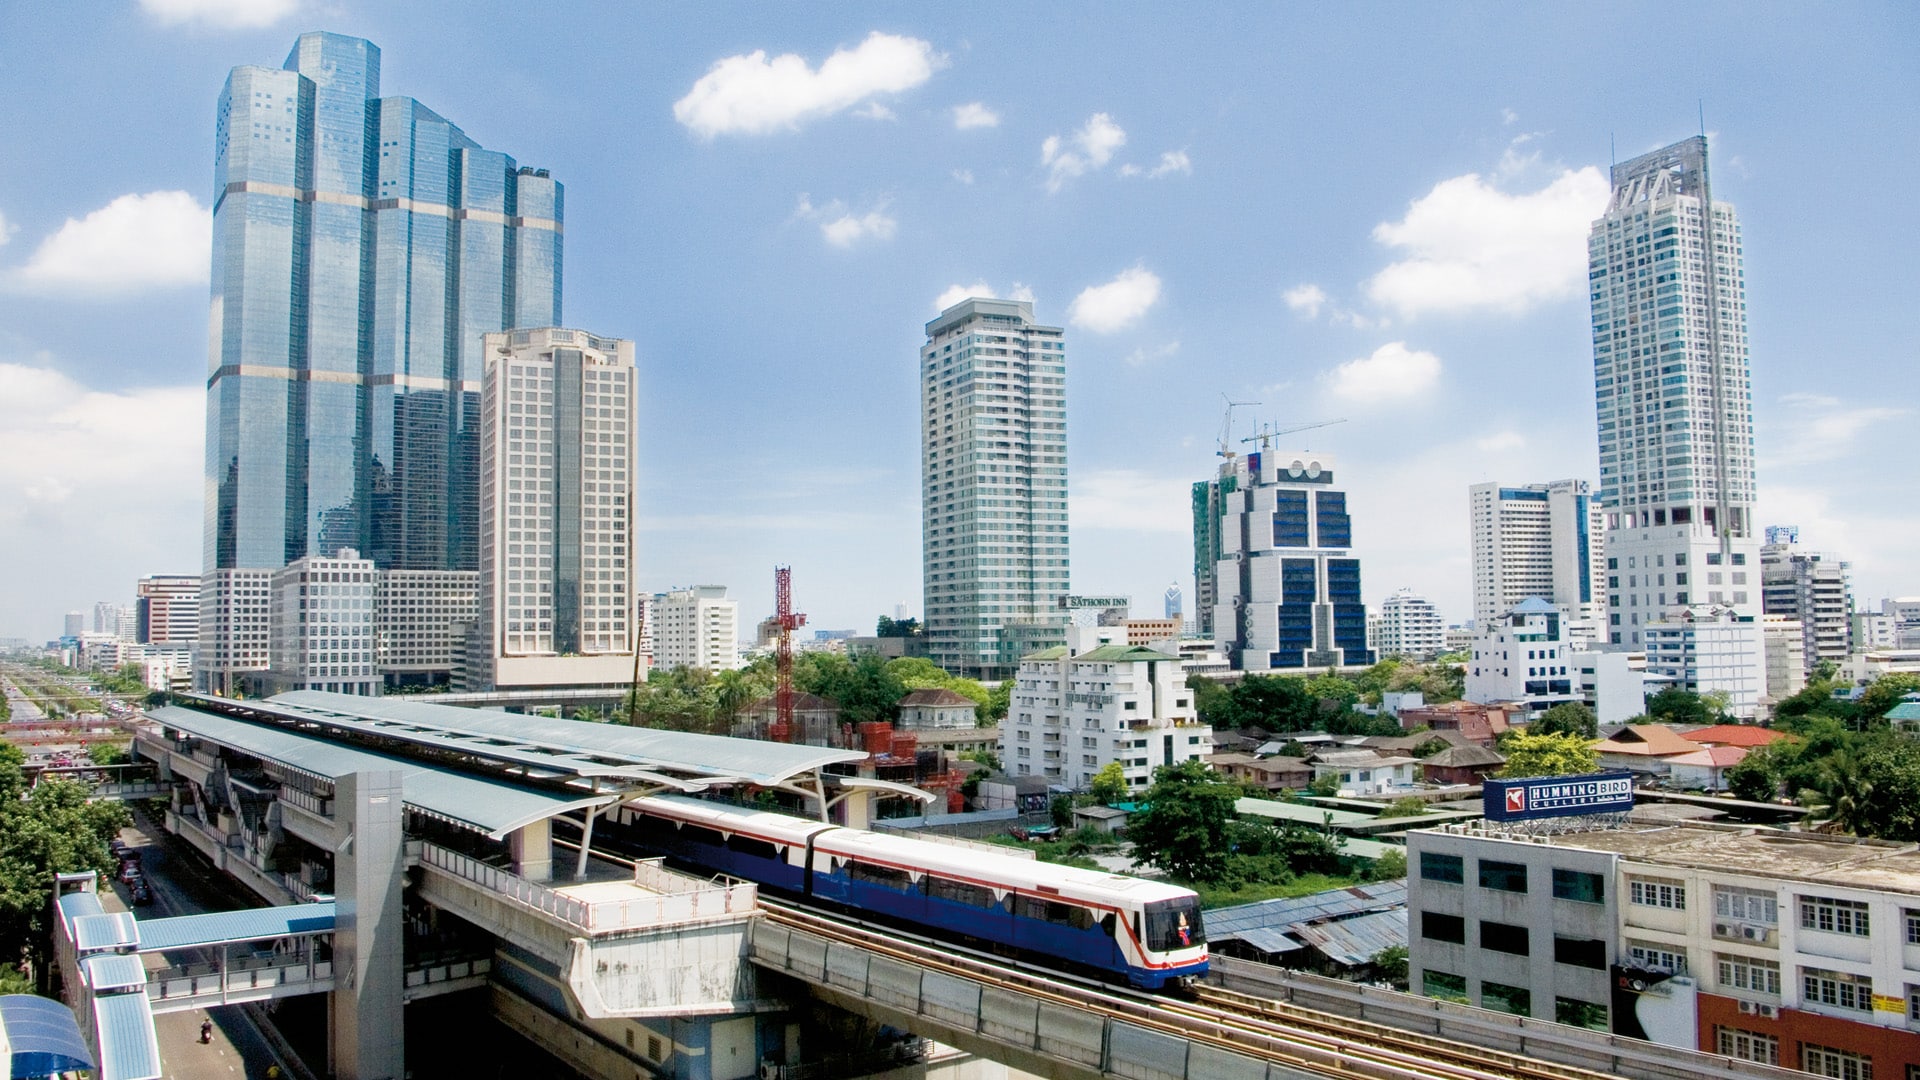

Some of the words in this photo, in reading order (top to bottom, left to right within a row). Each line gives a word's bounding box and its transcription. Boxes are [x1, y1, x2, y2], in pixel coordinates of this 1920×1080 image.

[1071, 598, 1111, 607] SATHORN
[1113, 598, 1128, 606] INN
[1532, 784, 1596, 799] HUMMING
[1600, 781, 1628, 793] BIRD
[1532, 797, 1594, 808] CUTLERY
